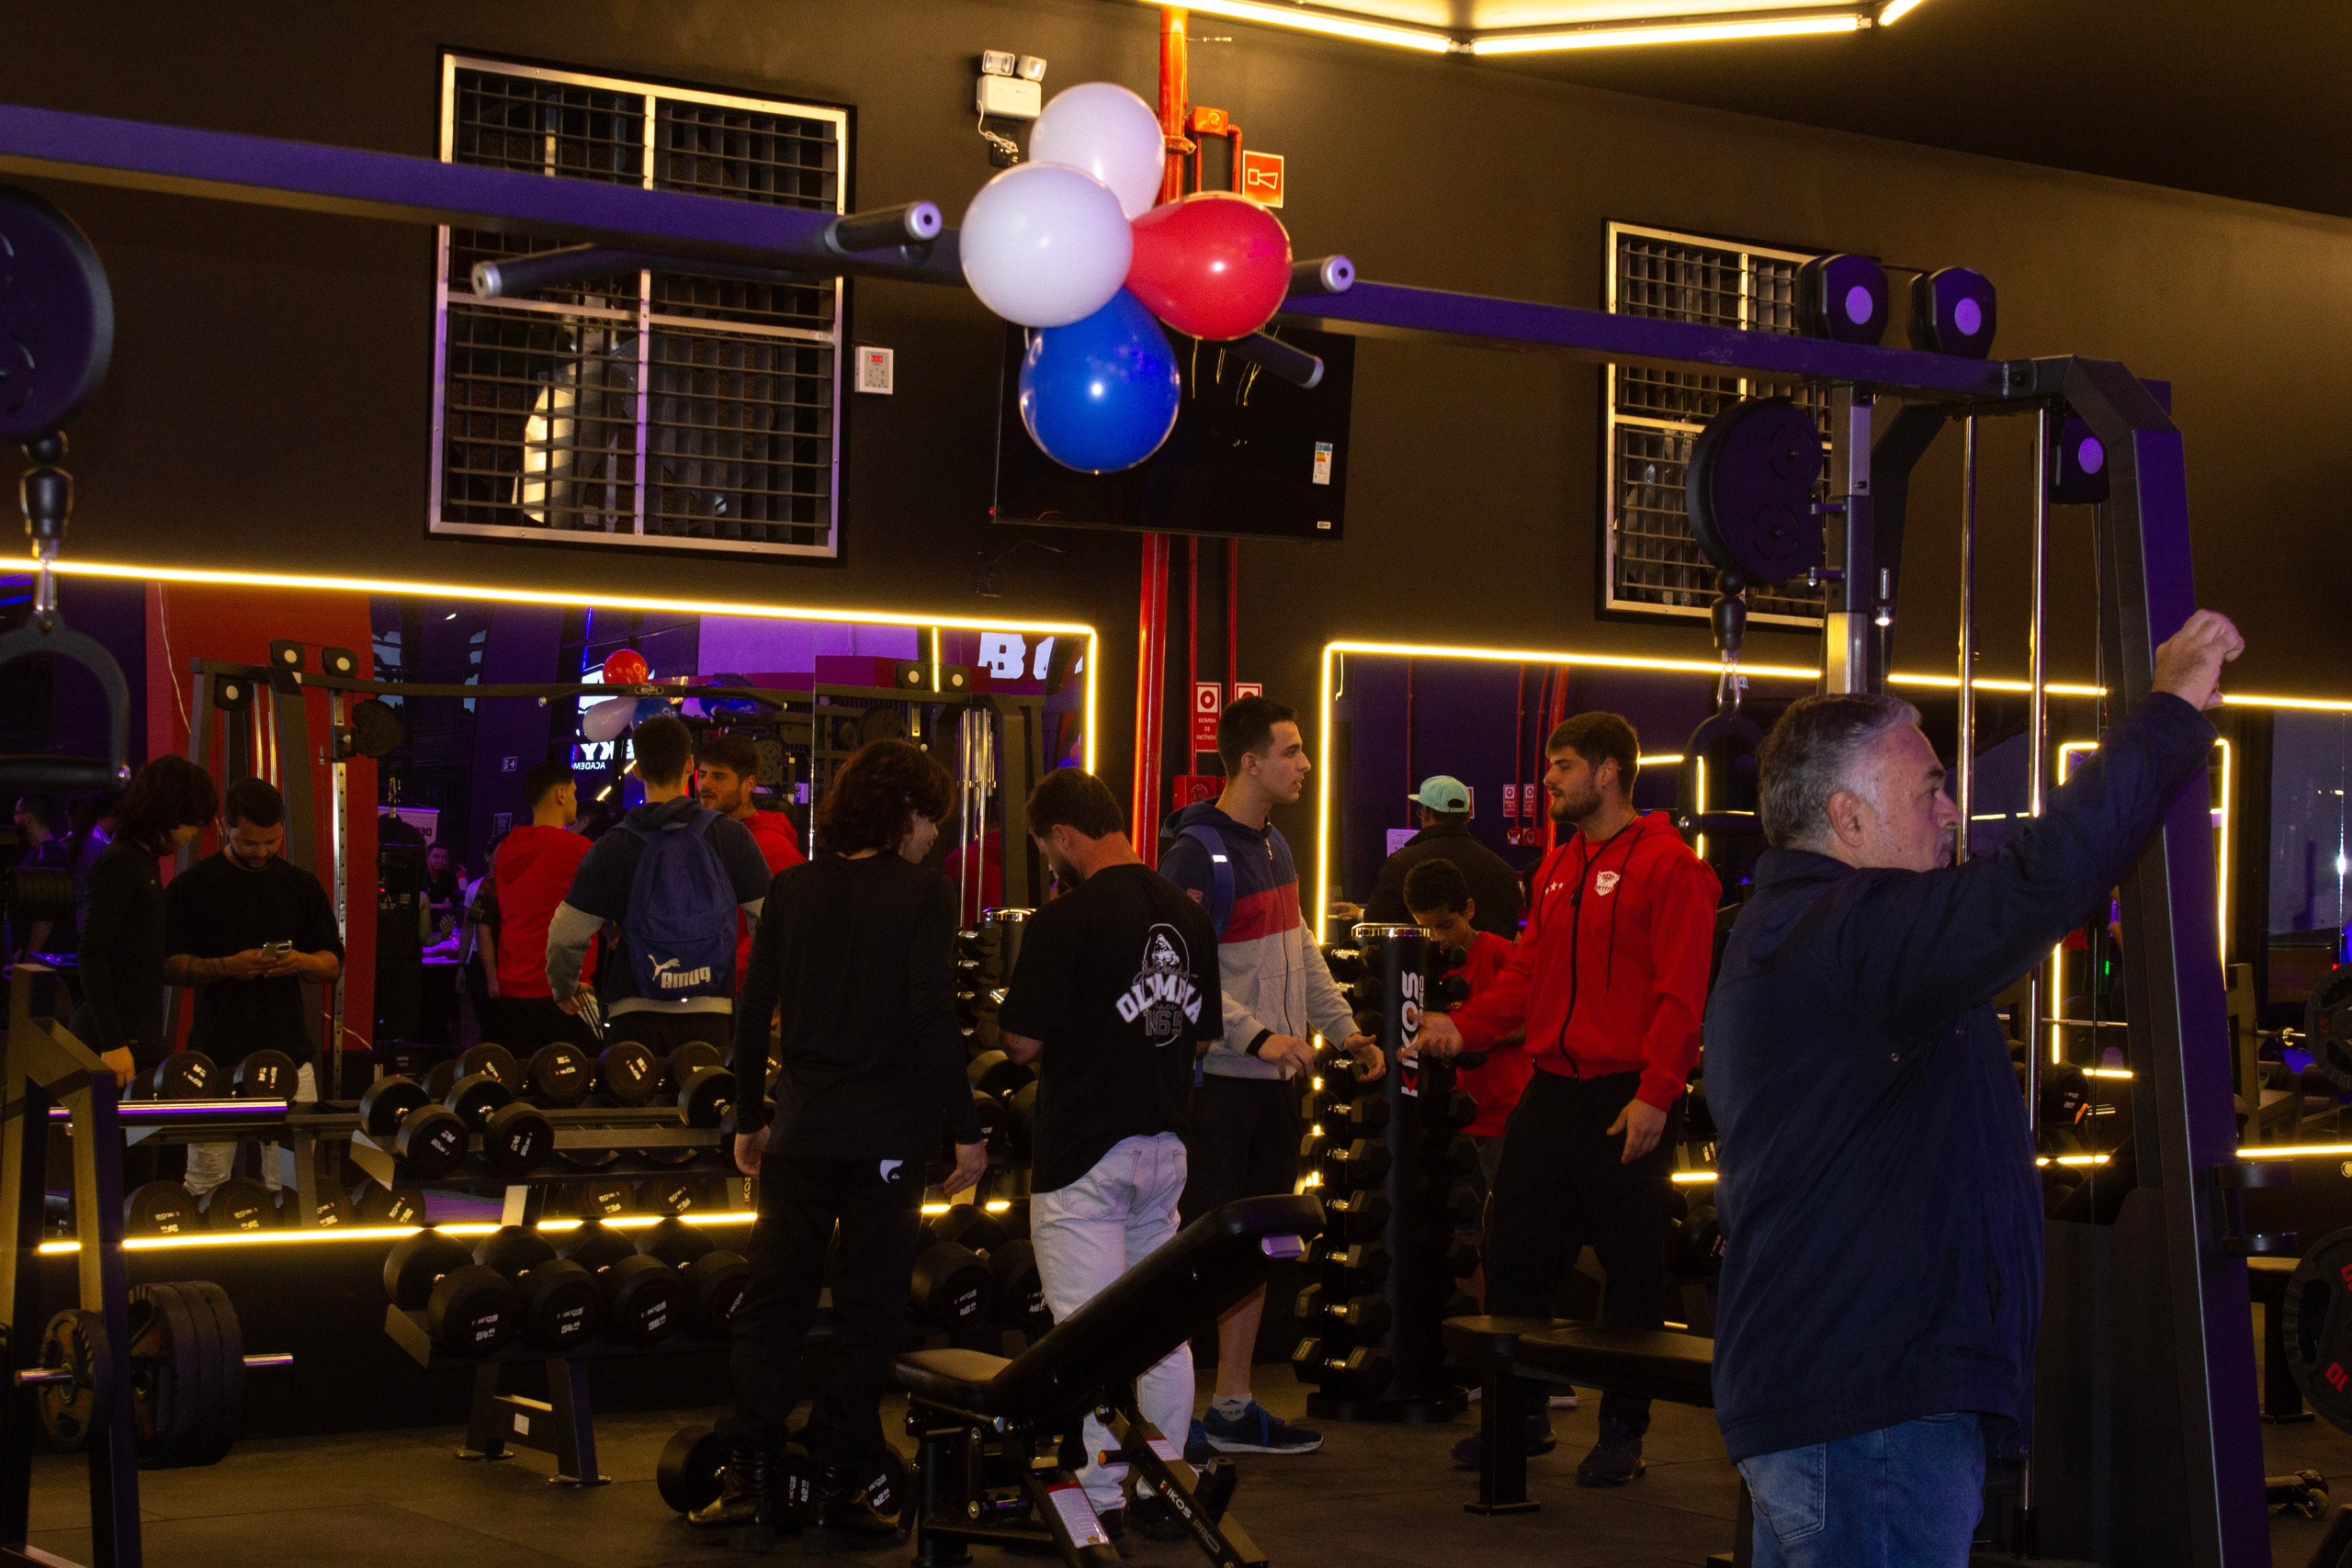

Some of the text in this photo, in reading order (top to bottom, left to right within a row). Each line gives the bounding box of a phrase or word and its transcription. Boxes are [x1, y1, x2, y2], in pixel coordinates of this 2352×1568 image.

[1143, 1010, 1183, 1037] 165
[1401, 970, 1419, 1099] KIKOS
[1159, 1480, 1193, 1519] KIKOS
[1193, 1517, 1221, 1554] PRO
